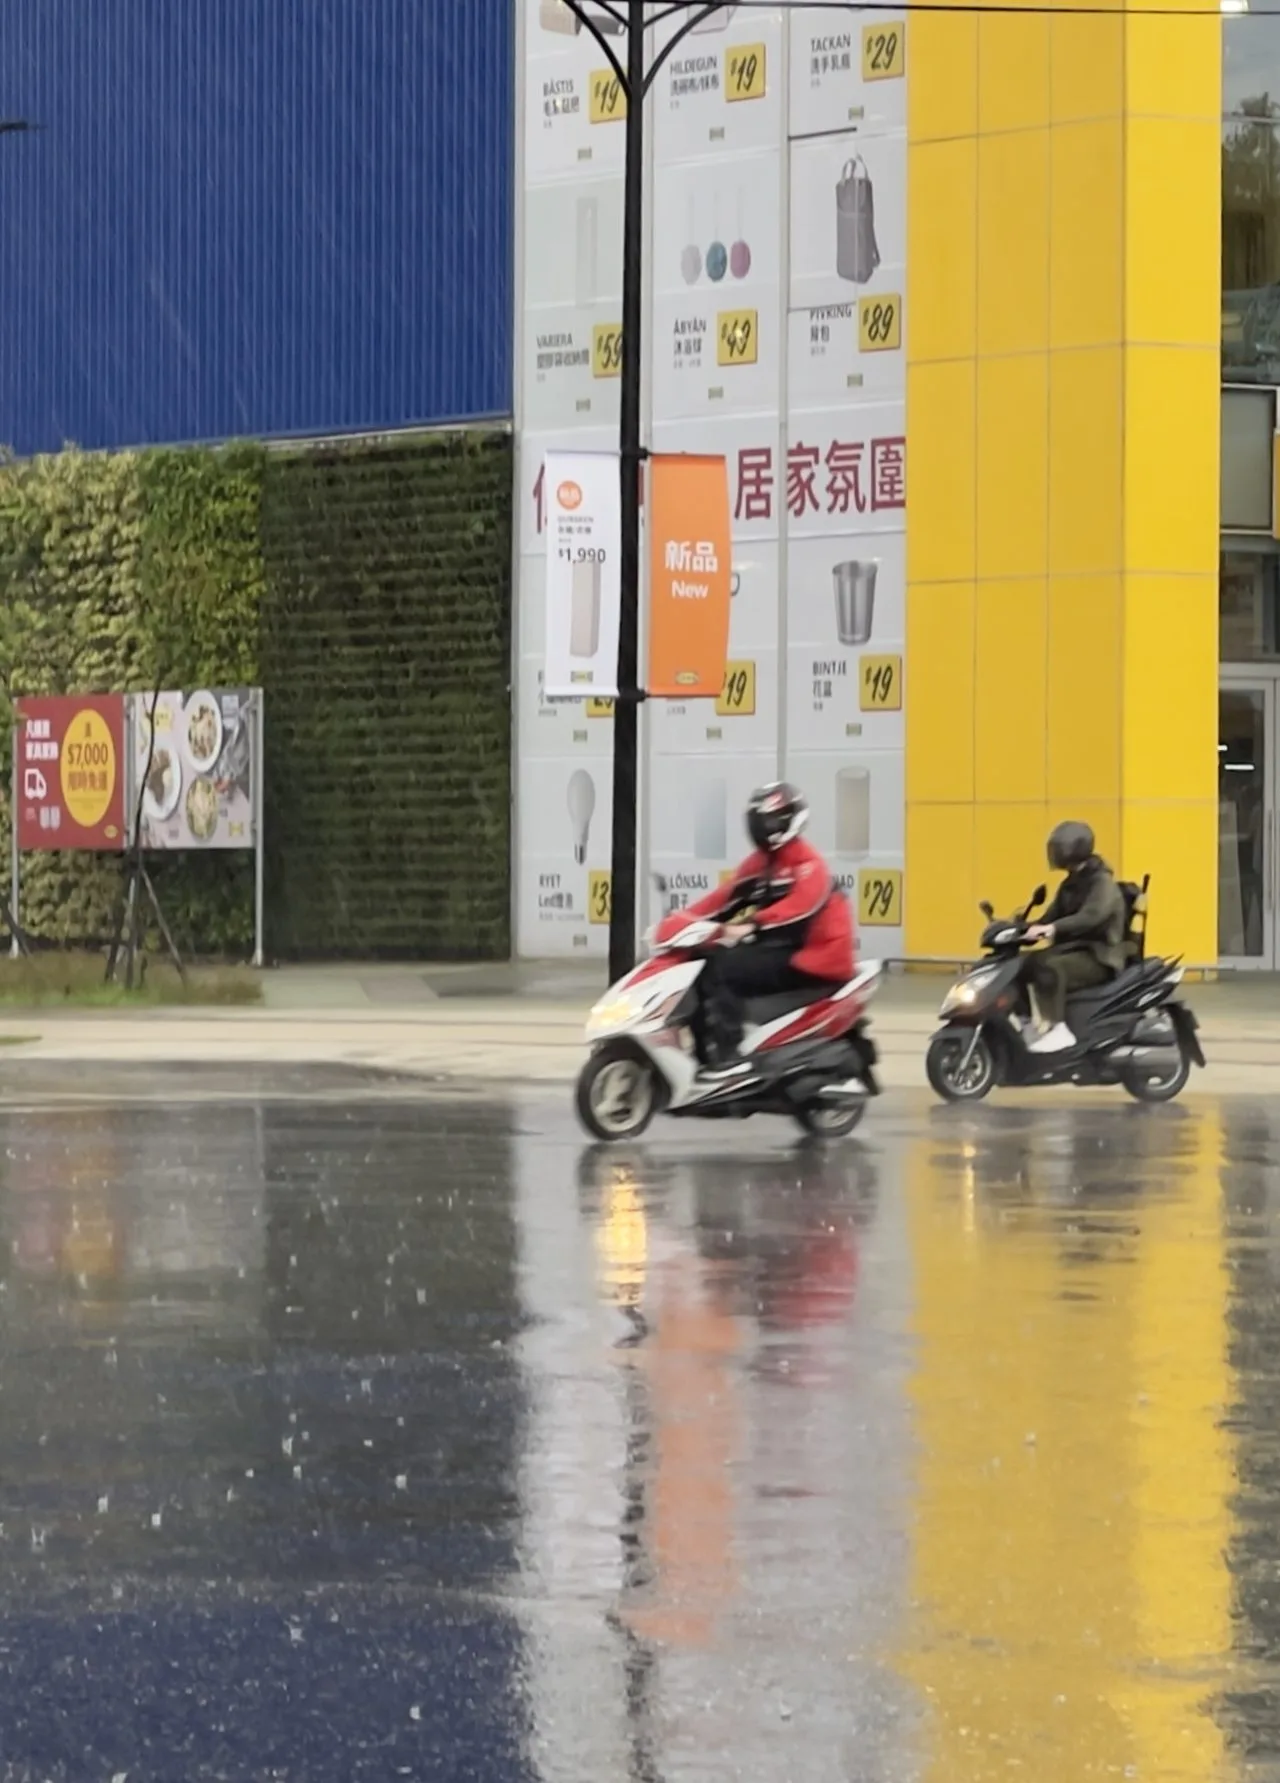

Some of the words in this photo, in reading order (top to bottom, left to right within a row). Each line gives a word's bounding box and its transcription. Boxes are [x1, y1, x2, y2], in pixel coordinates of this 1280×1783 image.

[810, 33, 851, 53] TACKAN
[866, 32, 897, 71] $29
[670, 56, 717, 75] HILDEGUN
[730, 53, 757, 92] $19
[594, 78, 620, 113] $19
[721, 318, 751, 357] $49
[863, 303, 894, 342] $89
[558, 547, 606, 565] $1,990
[665, 540, 718, 573] 新品
[671, 580, 709, 599] New
[812, 660, 846, 676] BINTJE
[865, 664, 893, 702] $19
[67, 743, 108, 769] $7,000
[864, 879, 894, 917] $79
